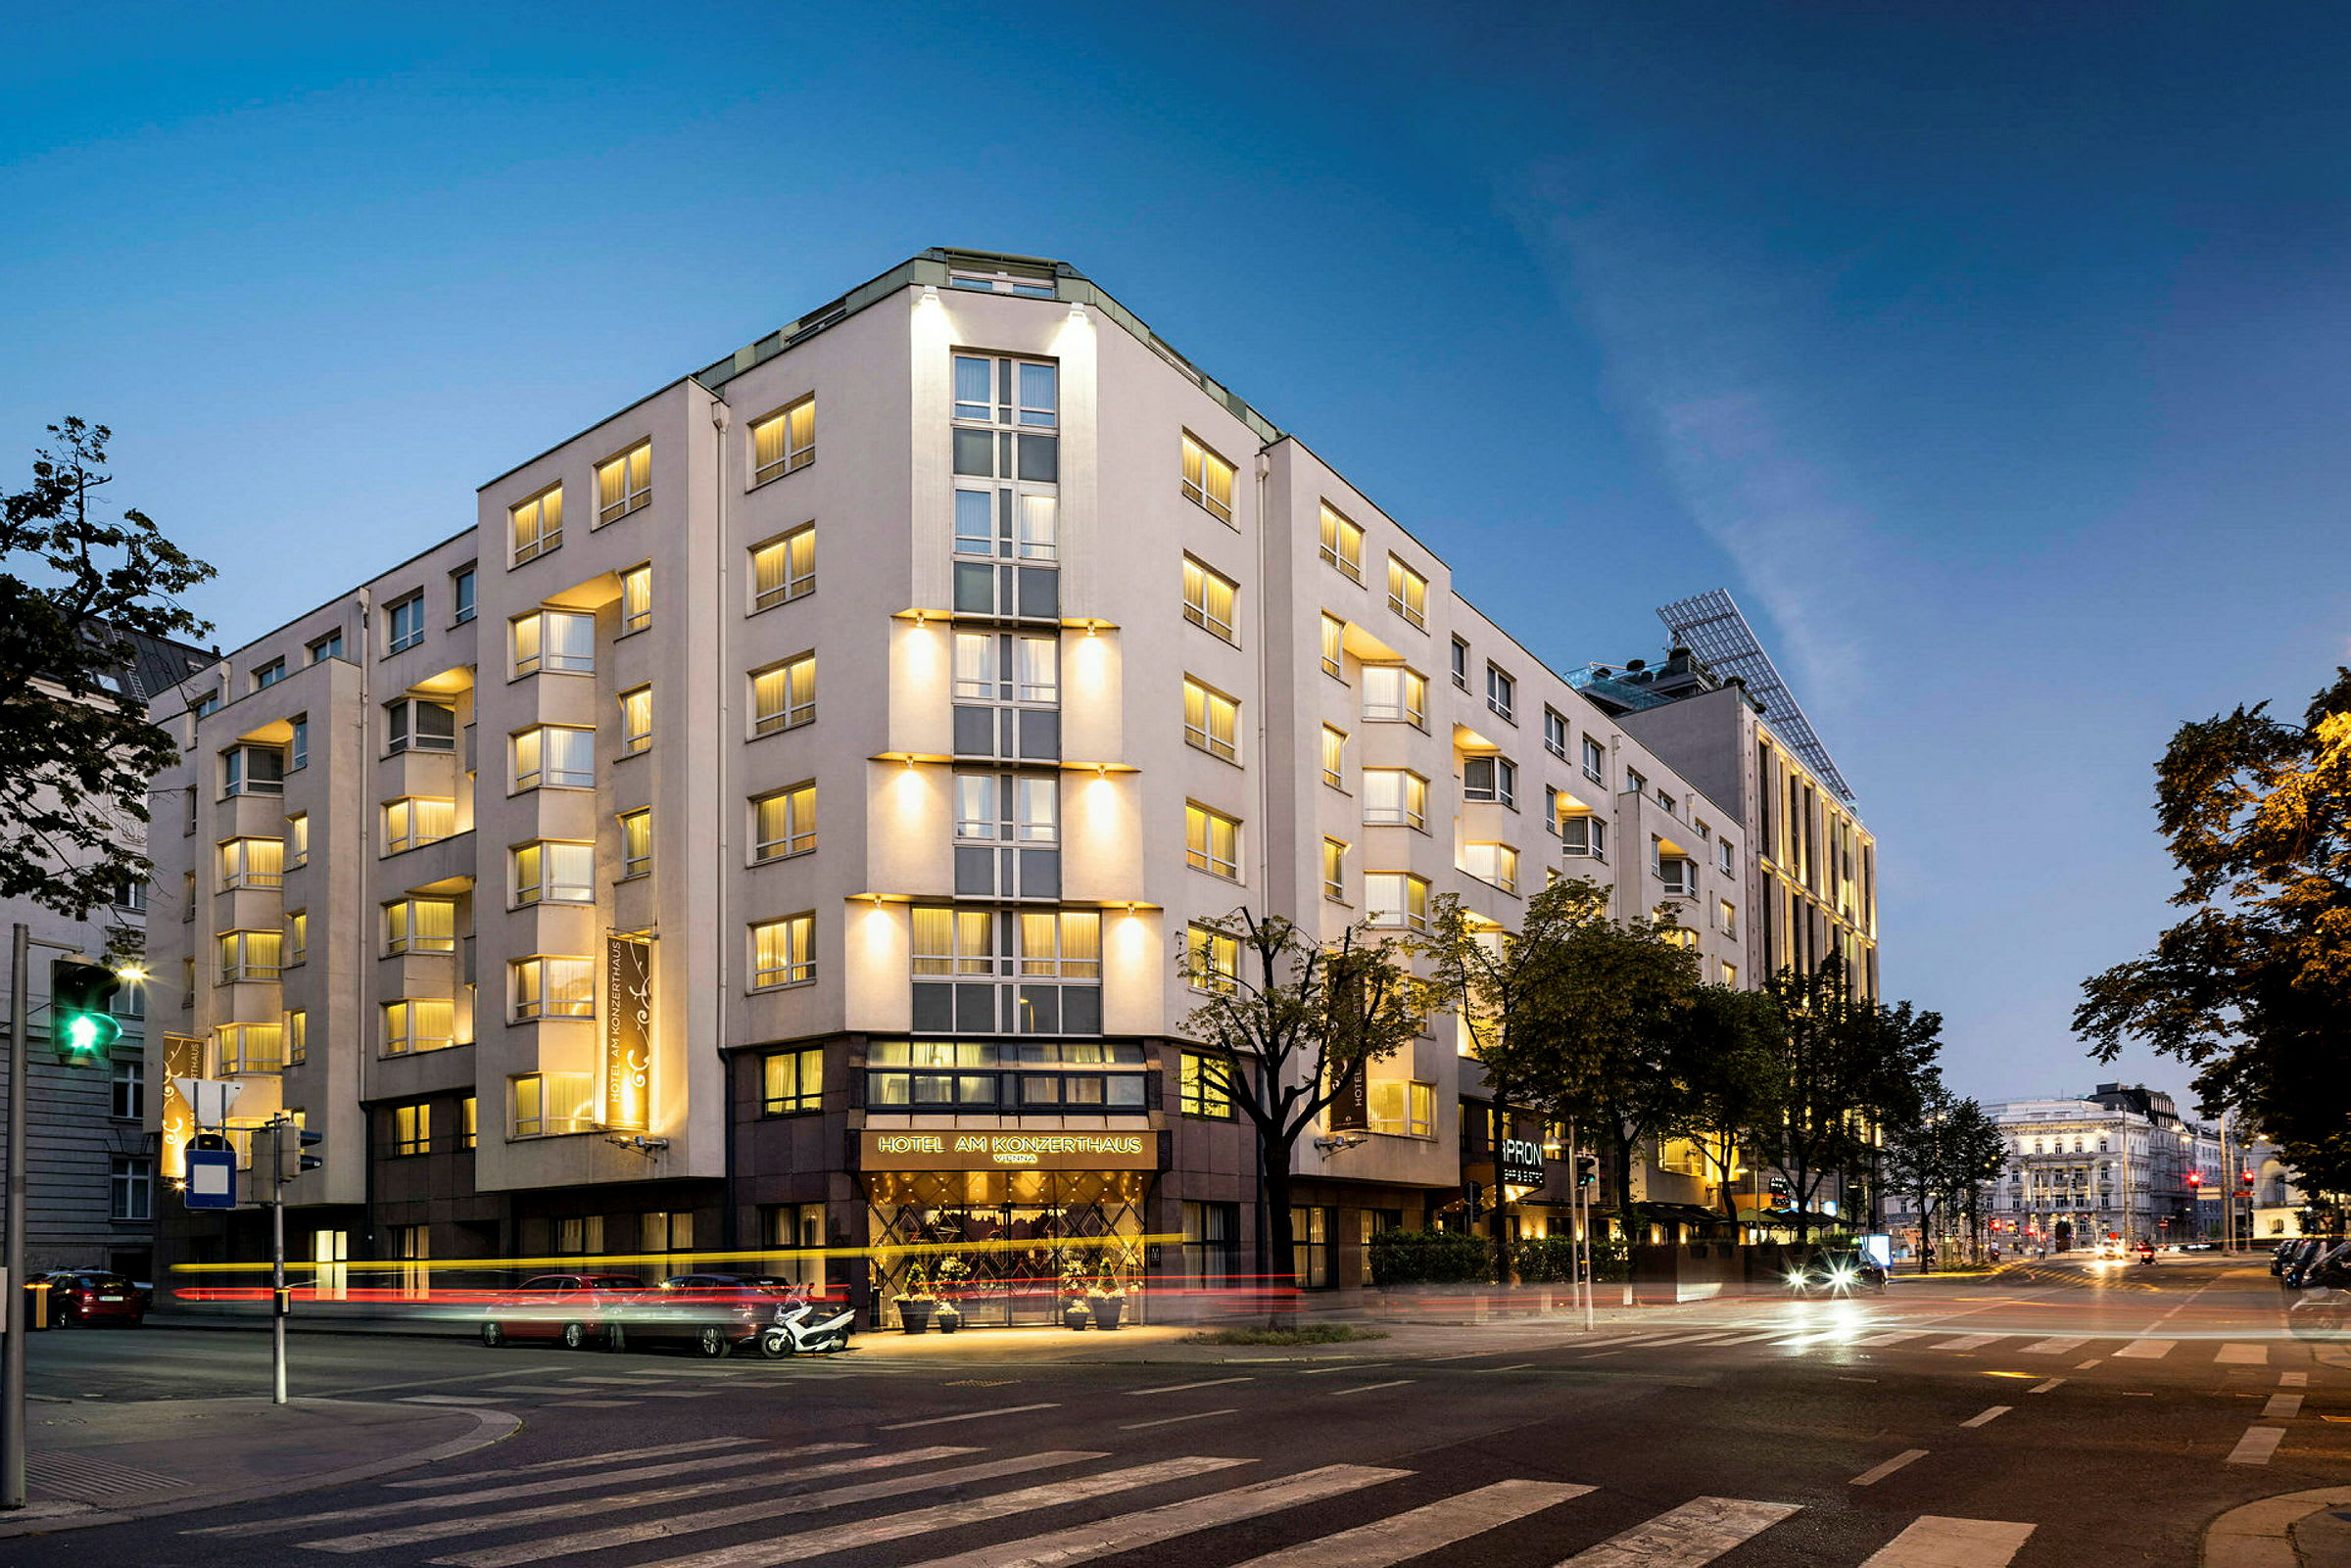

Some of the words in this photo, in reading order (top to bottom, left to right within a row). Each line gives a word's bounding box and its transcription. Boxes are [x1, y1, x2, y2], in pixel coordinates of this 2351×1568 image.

[611, 941, 621, 1035] KONZERTHAUS
[611, 1038, 620, 1058] AM
[610, 1062, 620, 1103] HOTEL
[1354, 1069, 1363, 1107] HOTEL
[879, 1136, 946, 1153] HOTEL
[955, 1136, 987, 1153] AM
[992, 1136, 1142, 1153] KONZERTHAUS
[993, 1154, 1037, 1164] VIENNA
